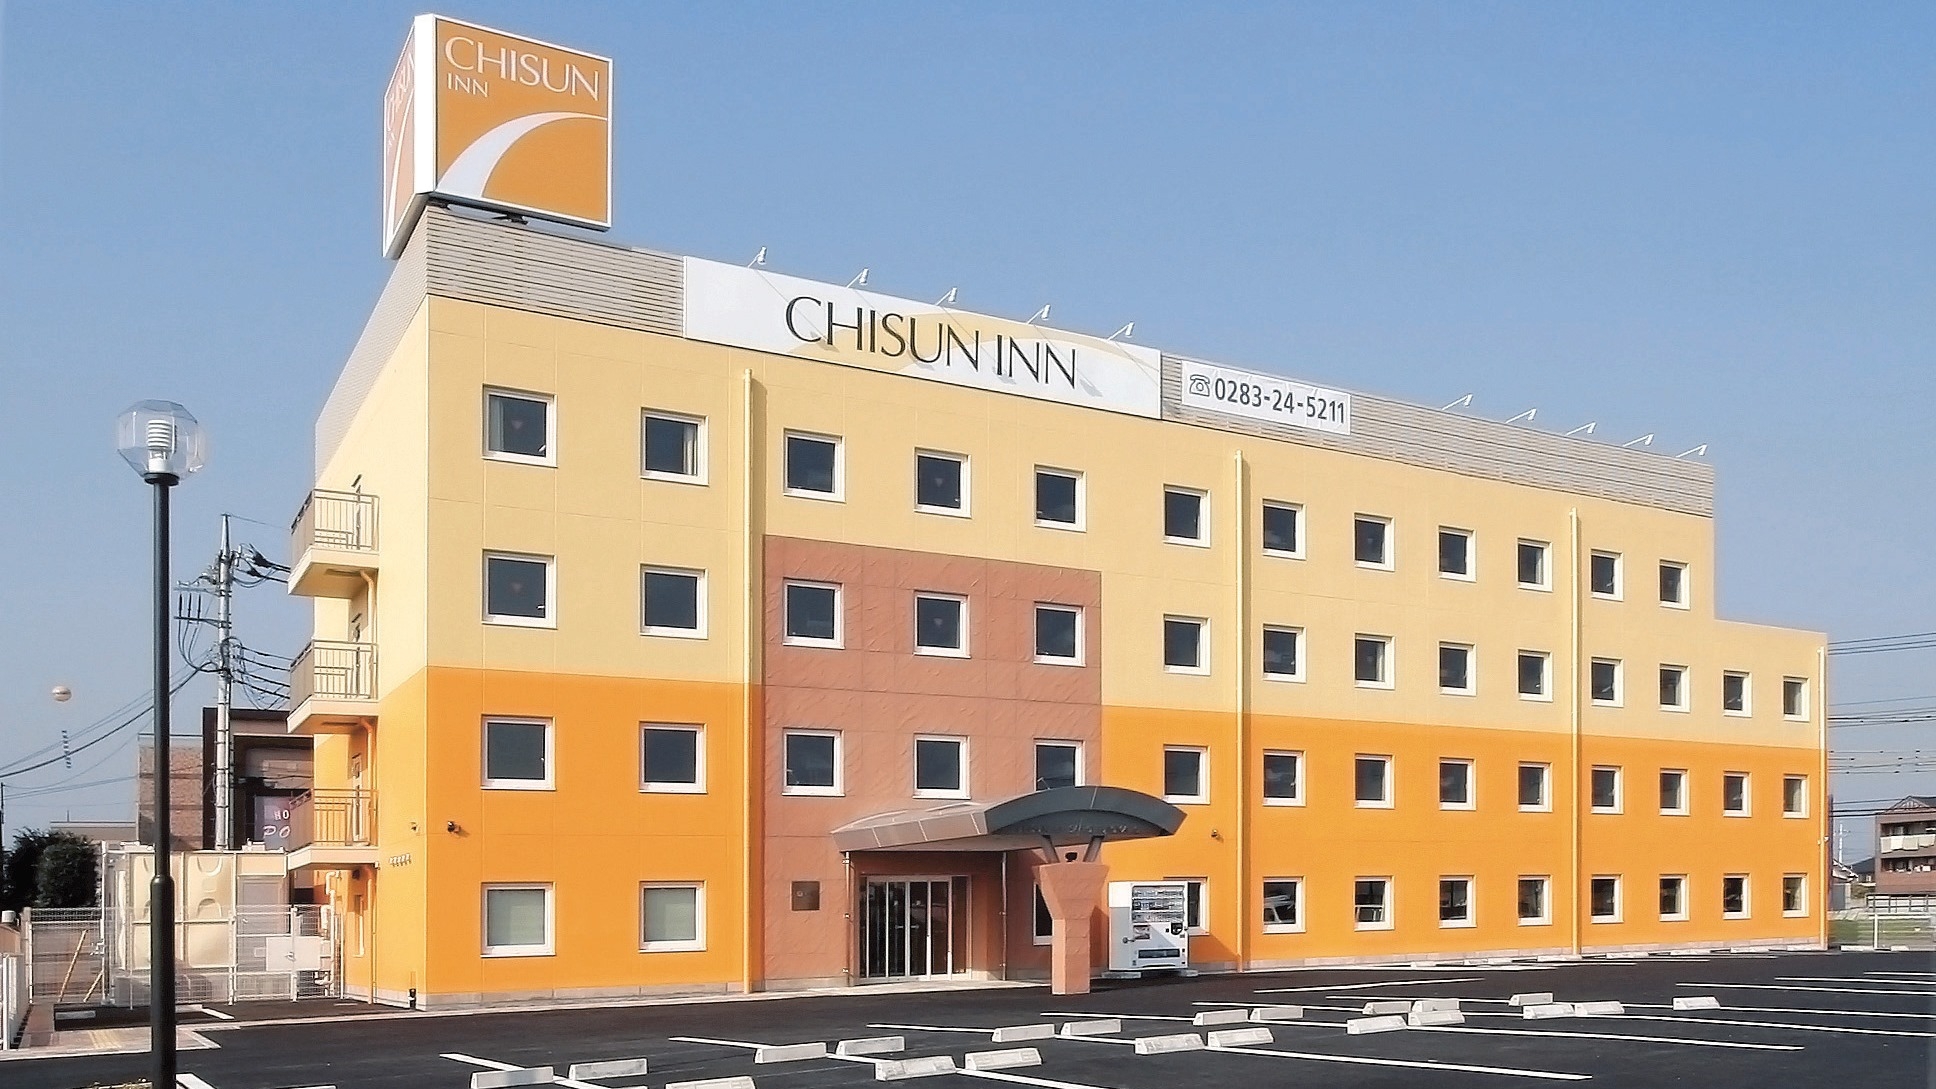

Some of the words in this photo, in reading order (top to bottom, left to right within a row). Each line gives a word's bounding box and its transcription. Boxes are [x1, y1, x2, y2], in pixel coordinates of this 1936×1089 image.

[445, 36, 599, 101] CHISUN
[447, 72, 489, 98] INN
[785, 296, 980, 372] CHISUN
[996, 334, 1077, 389] INN
[1214, 377, 1345, 424] 0283-24-5211
